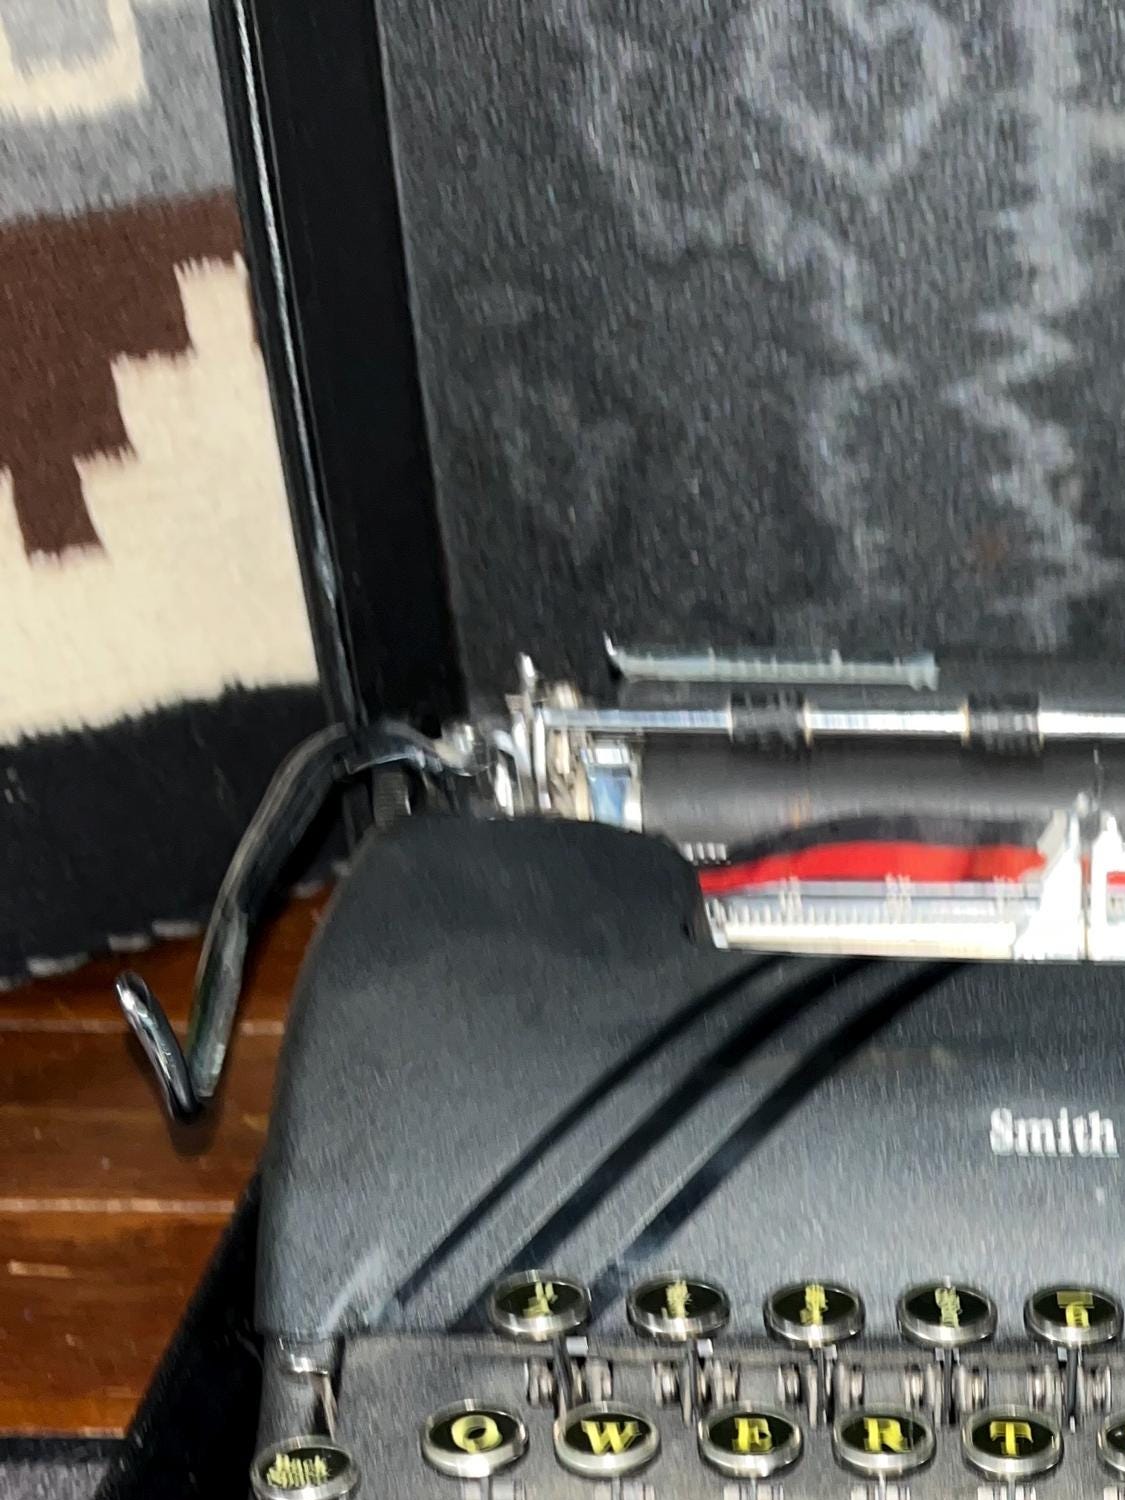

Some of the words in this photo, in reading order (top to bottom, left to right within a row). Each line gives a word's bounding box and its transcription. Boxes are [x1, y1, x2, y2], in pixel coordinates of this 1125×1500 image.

[990, 1107, 1119, 1158] Smith
[583, 1420, 637, 1456] W
[864, 1417, 905, 1454] R
[989, 1420, 1032, 1458] T
